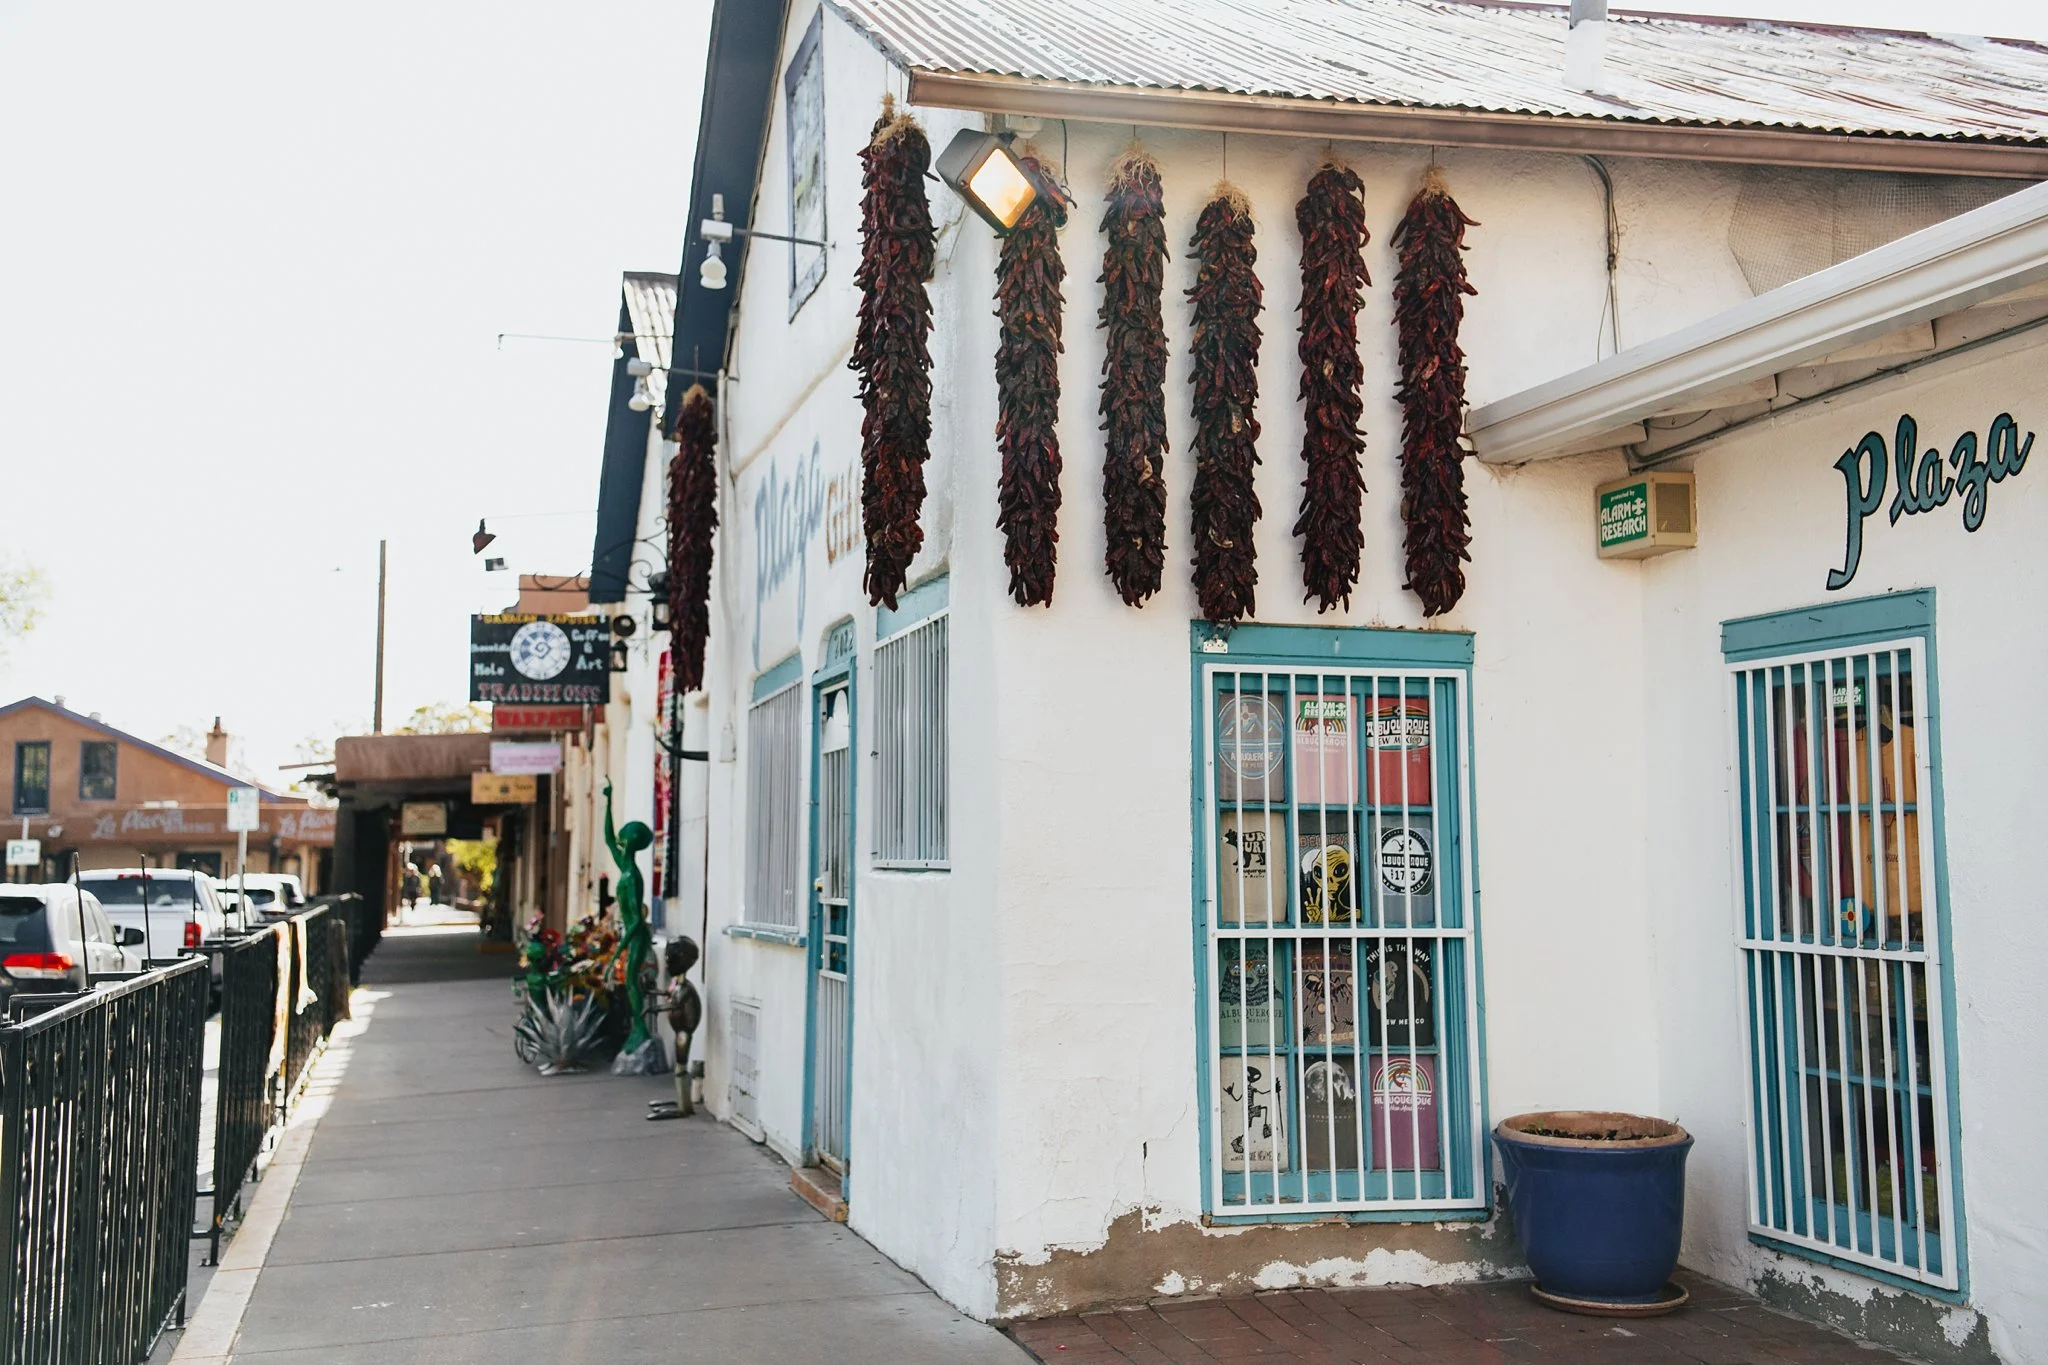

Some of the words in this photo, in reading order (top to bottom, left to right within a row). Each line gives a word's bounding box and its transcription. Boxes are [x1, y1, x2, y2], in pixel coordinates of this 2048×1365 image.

[1825, 411, 2036, 591] Plaza
[1601, 501, 1632, 525] ALARM
[1602, 515, 1647, 541] RESEARCH
[576, 655, 604, 671] Art
[478, 682, 602, 701] TRADITIONS
[1831, 694, 1862, 705] ESEACH
[1304, 709, 1346, 717] RESARCH
[1366, 719, 1429, 736] ABUQURQUE
[1296, 737, 1347, 746] ALBUQERQU
[1380, 855, 1429, 867] LBUQURQUE
[1396, 943, 1411, 952] TH
[1414, 947, 1430, 963] WAY
[1383, 1018, 1397, 1026] EW
[1398, 1018, 1425, 1026] MECO
[1374, 1096, 1432, 1106] ALUQUEQUE
